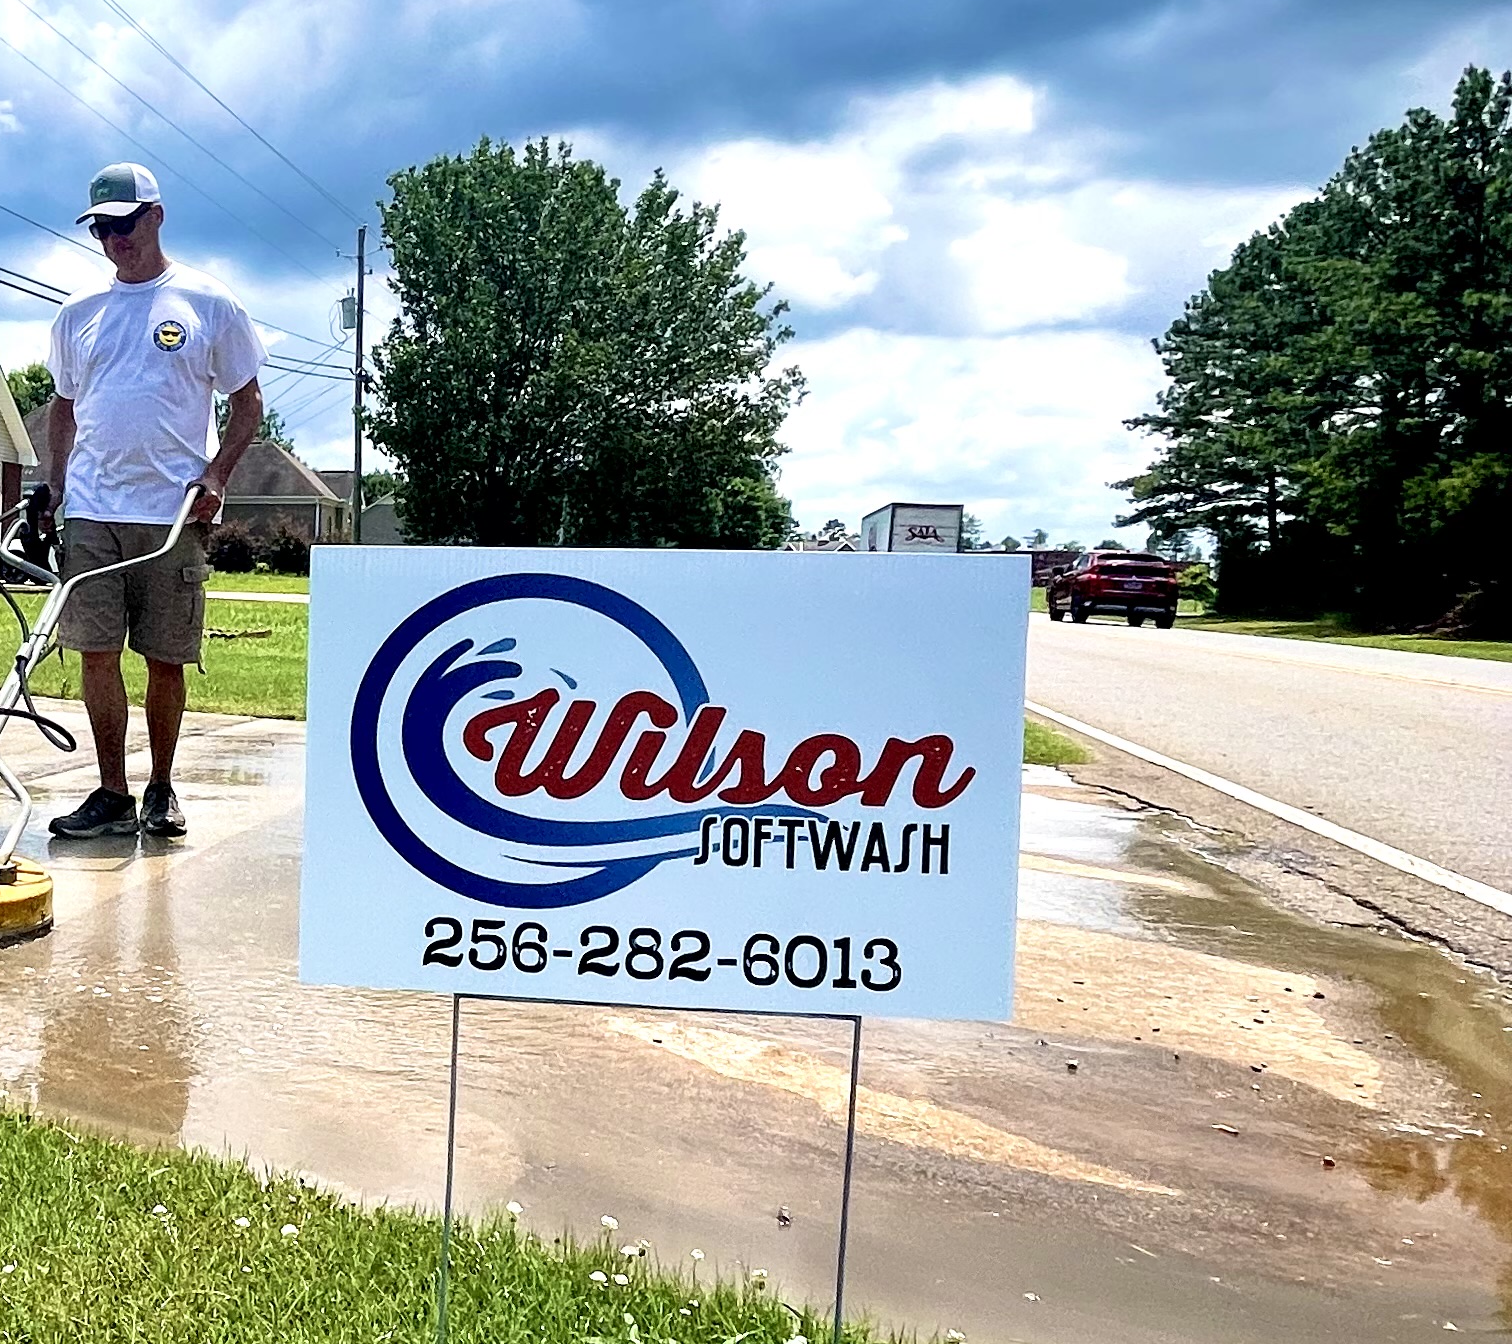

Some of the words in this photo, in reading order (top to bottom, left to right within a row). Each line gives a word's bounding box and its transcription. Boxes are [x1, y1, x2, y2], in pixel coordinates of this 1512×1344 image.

[463, 688, 976, 809] Wilson
[693, 816, 951, 875] SOFTWASH
[422, 916, 903, 993] 256-282-6013
